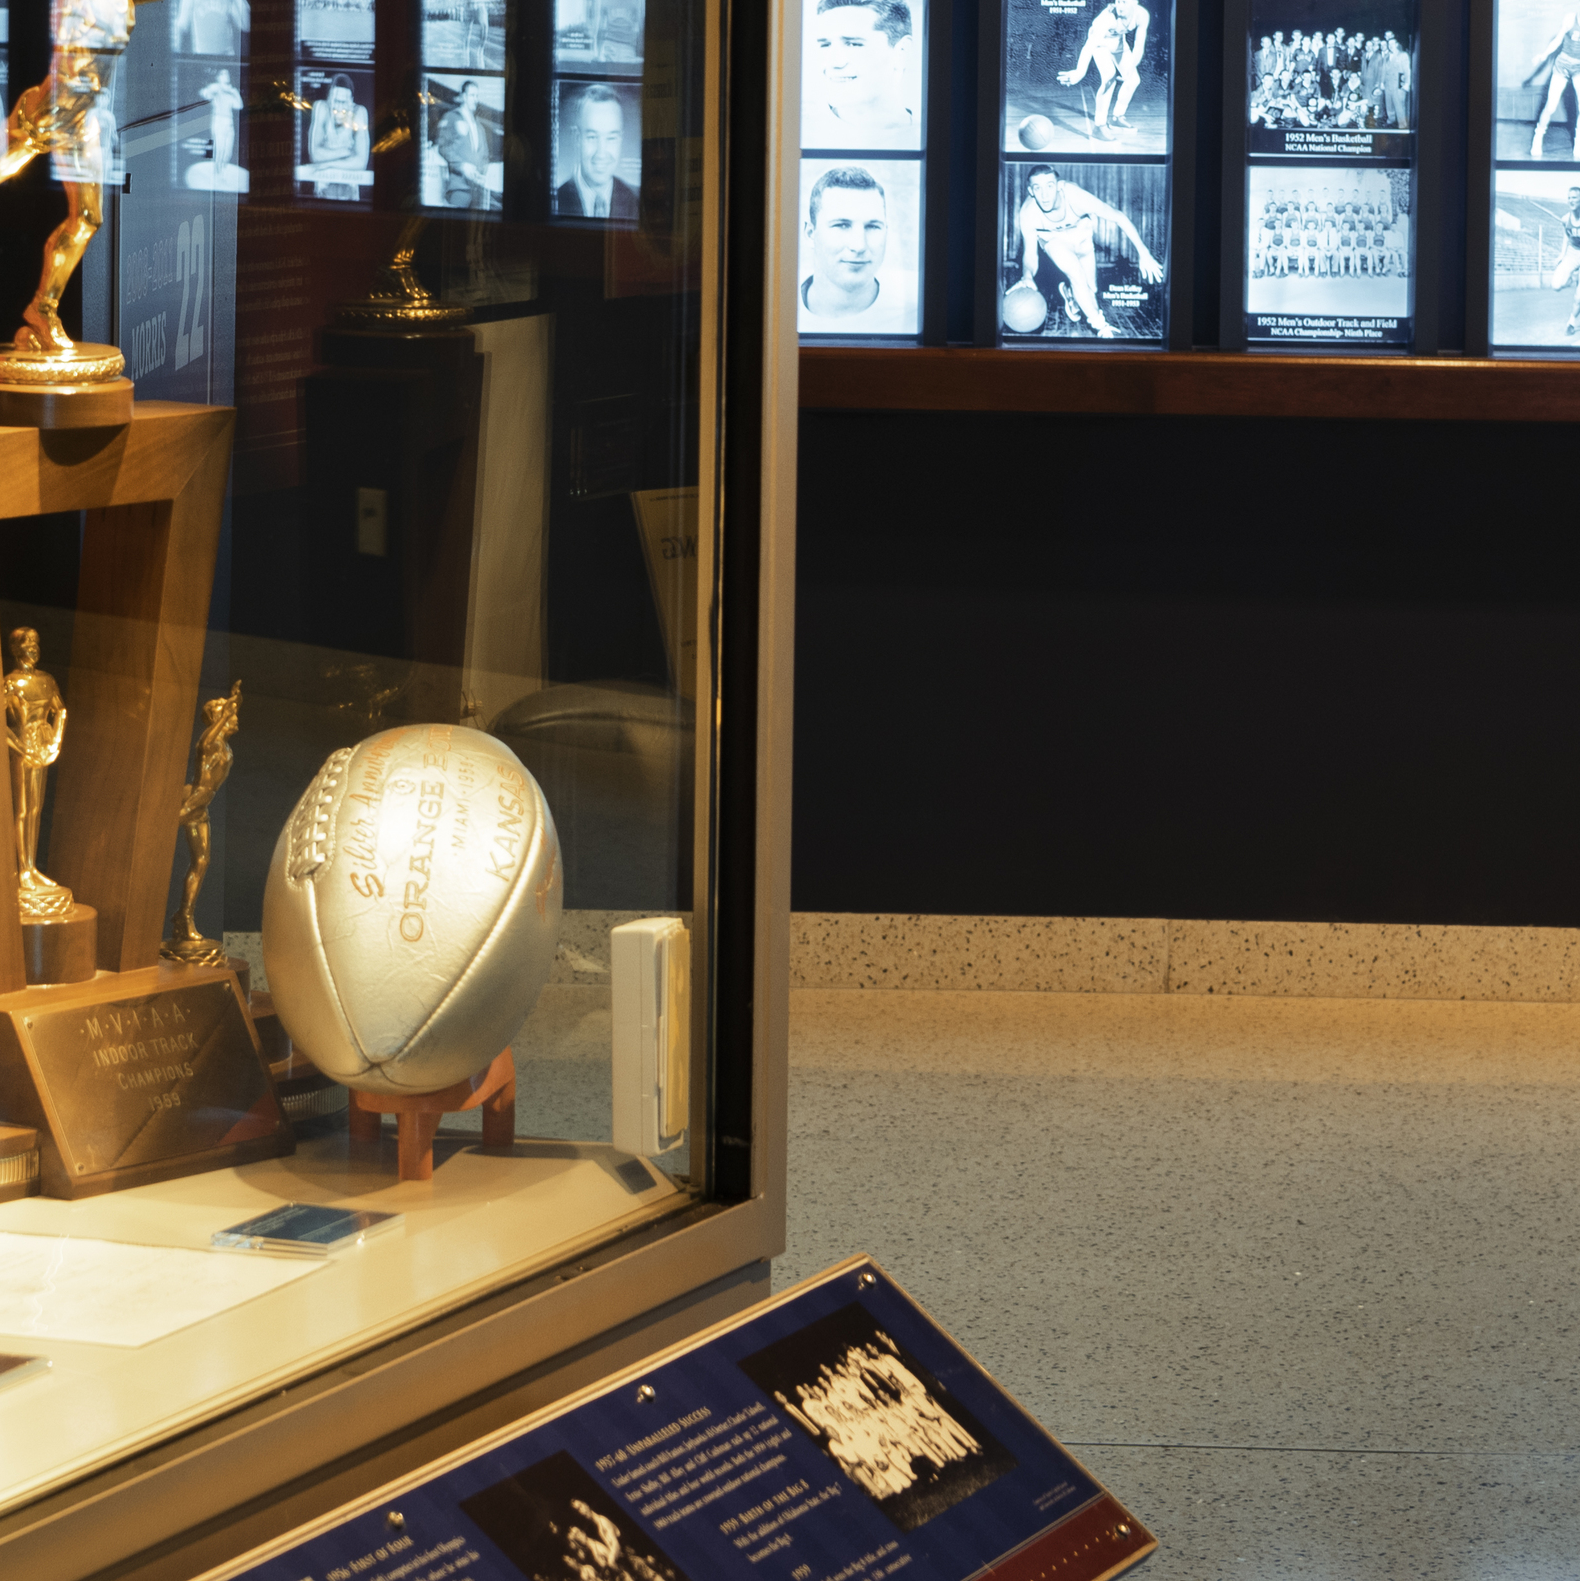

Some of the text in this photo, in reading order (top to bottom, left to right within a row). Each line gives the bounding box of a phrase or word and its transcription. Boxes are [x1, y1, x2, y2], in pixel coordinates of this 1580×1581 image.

[1284, 143, 1371, 153] NCAA National Champion
[1285, 132, 1372, 143] 1952 Men's Basketball
[1257, 316, 1397, 328] 1952 Men's Outdoor Track and Field
[485, 765, 524, 882] KANSAS
[399, 780, 445, 943] ORANGE
[93, 1032, 198, 1067] INDOOR TRACK
[118, 1061, 194, 1090] CHAMPIONS
[149, 1092, 181, 1111] 1959
